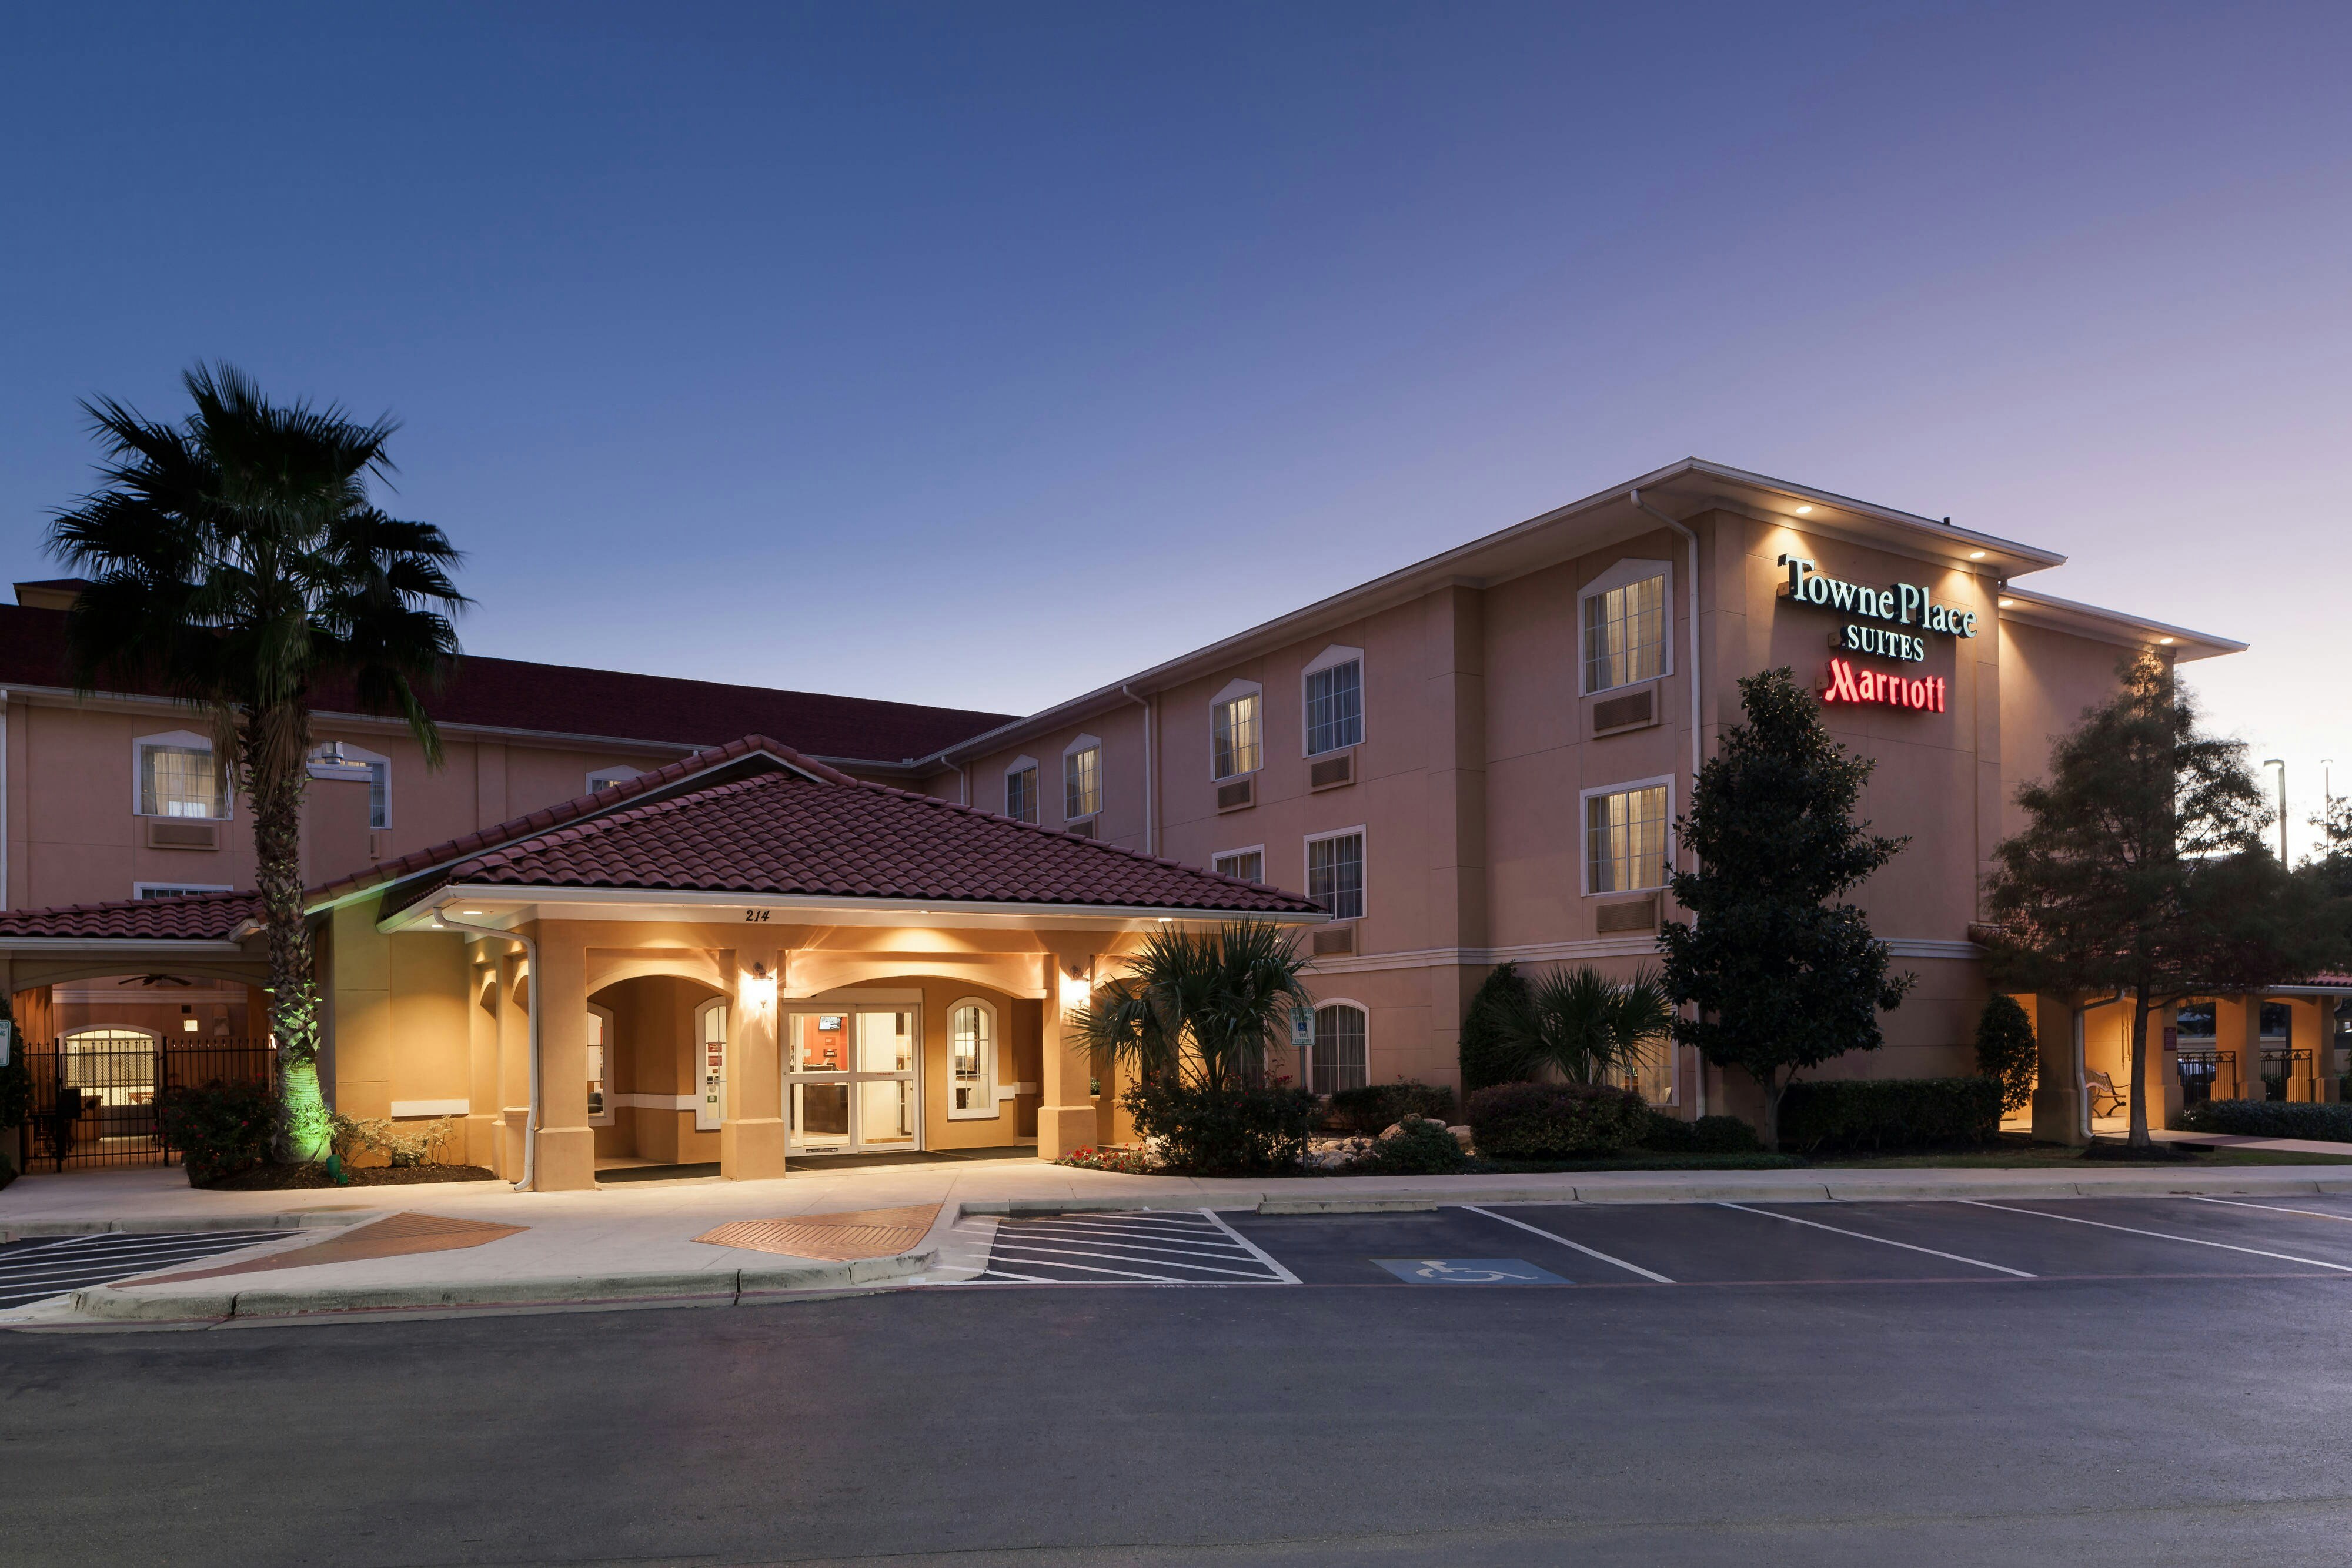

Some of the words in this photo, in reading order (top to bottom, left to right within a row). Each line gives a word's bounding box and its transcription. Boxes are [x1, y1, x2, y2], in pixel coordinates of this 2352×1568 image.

[1783, 553, 1977, 638] TownePlace
[1847, 624, 1925, 662] SUITES
[1825, 658, 1945, 713] Marriott
[746, 910, 770, 921] 214
